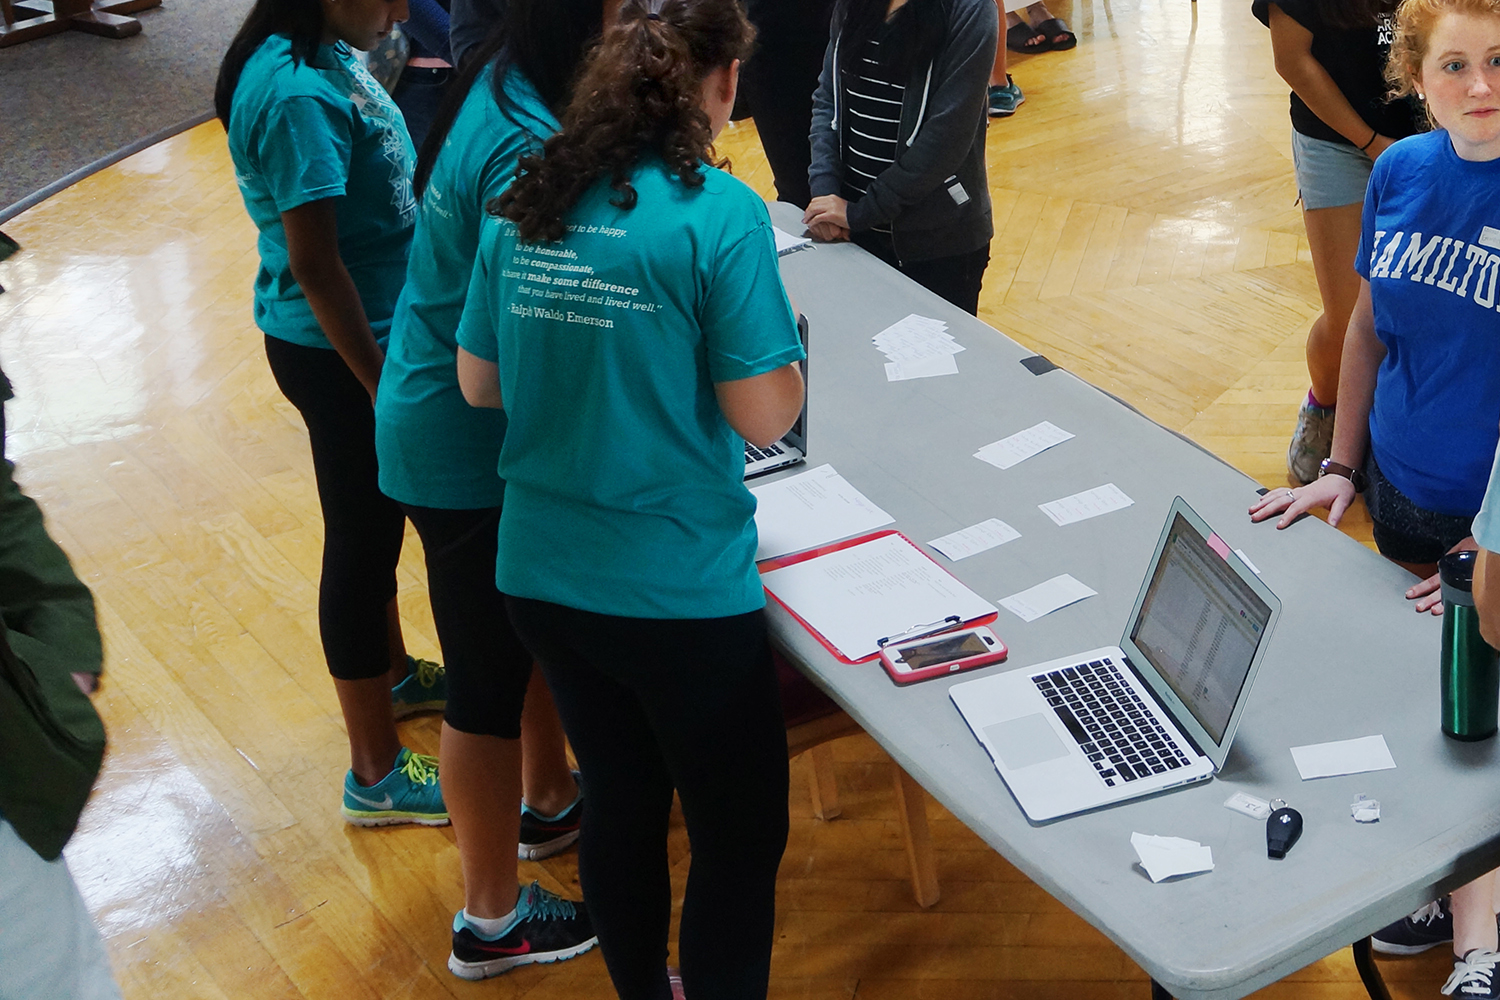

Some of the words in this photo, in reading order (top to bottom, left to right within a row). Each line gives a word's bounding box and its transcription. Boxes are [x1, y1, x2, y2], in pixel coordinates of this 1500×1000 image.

[586, 224, 598, 233] be
[598, 224, 627, 238] happy.
[523, 244, 534, 253] be
[534, 245, 579, 260] honorable,
[520, 256, 530, 266] be
[530, 260, 595, 276] compassionate,
[527, 273, 551, 284] make
[552, 277, 580, 287] some
[581, 278, 640, 296] difference
[564, 291, 586, 302] lived
[586, 296, 604, 305] and
[604, 296, 630, 309] lived
[533, 306, 564, 322] Waldo
[566, 311, 614, 329] Emerson
